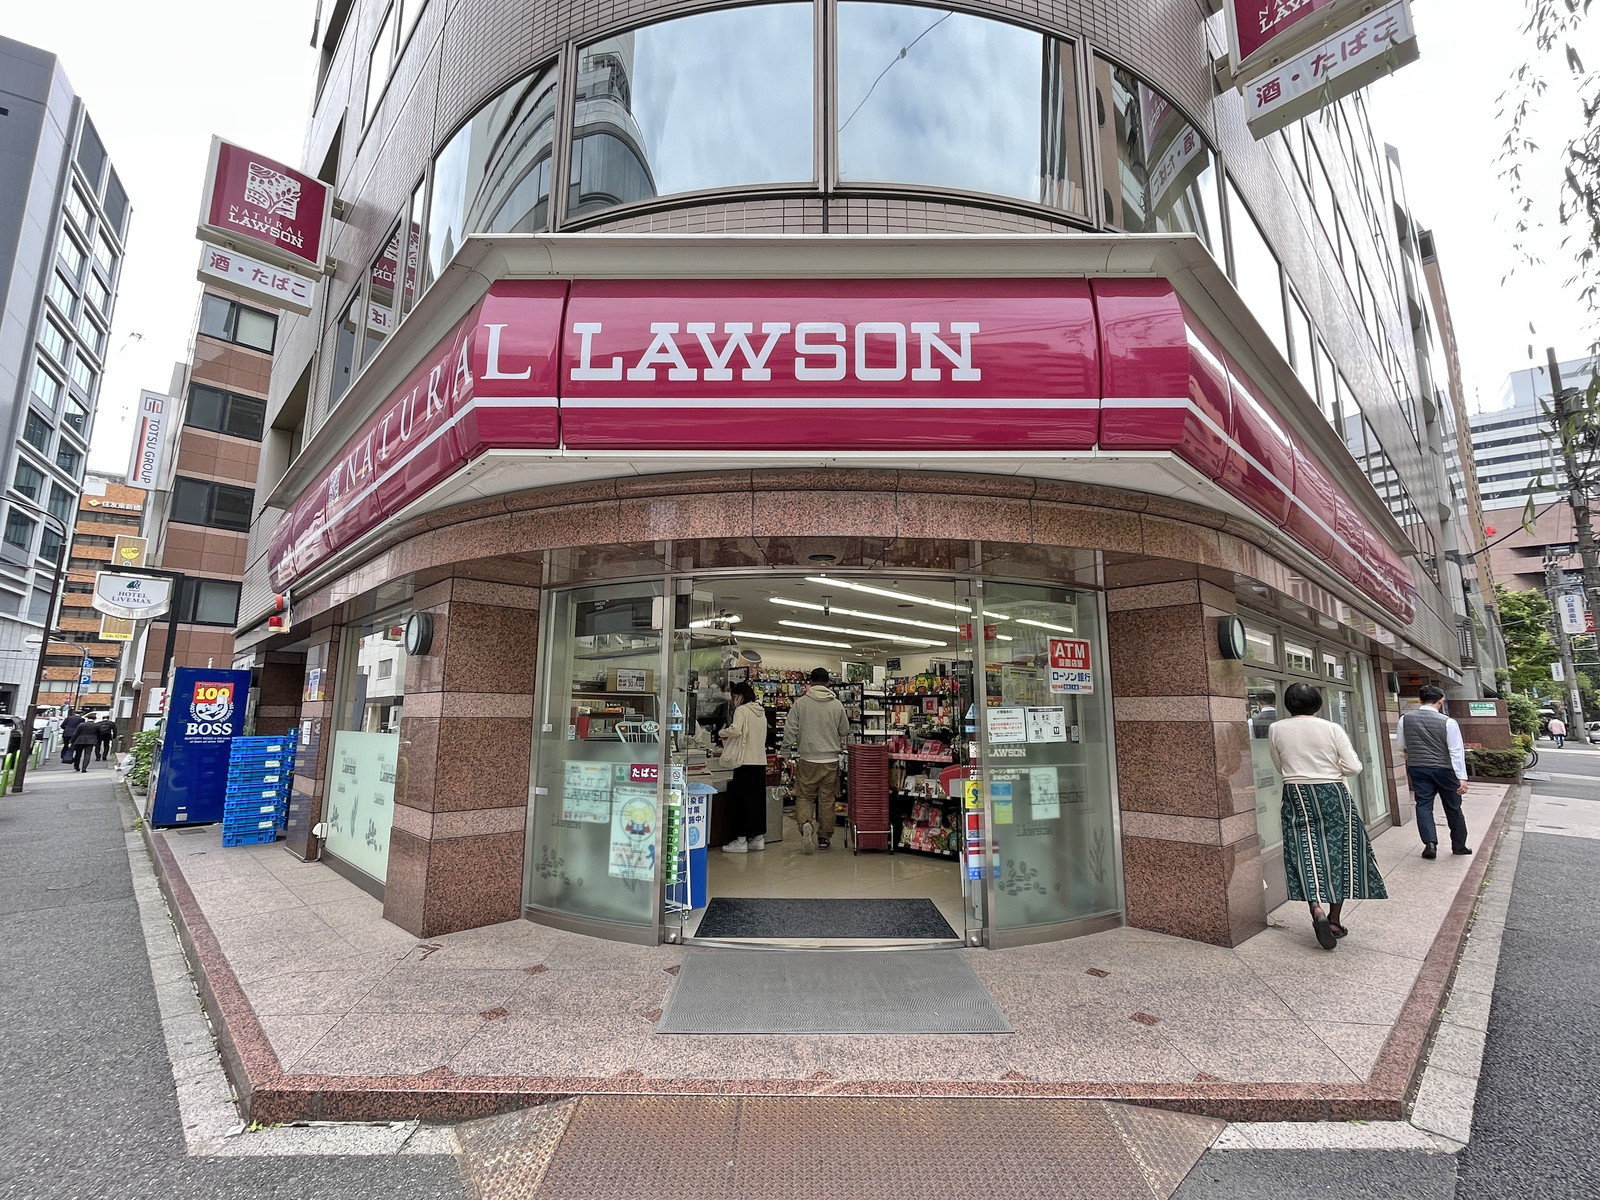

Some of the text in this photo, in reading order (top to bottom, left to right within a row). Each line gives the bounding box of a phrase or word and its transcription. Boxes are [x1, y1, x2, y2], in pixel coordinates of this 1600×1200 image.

[1256, 16, 1398, 108] 酒・たばこ
[230, 204, 304, 238] NATURAL
[228, 212, 304, 249] LAWSON
[209, 251, 306, 298] 酒・たばこ
[345, 321, 981, 494] NATURAL LAWSON
[141, 419, 160, 484] TOTSU GROUP
[118, 591, 148, 599] HOTEL
[1055, 642, 1085, 659] ATM
[81, 676, 89, 684] P
[1052, 671, 1092, 682] ローソン銀行
[196, 687, 230, 700] 100
[185, 722, 233, 736] BOSS
[988, 749, 1026, 757] LAWSON
[631, 767, 658, 778] たばこ
